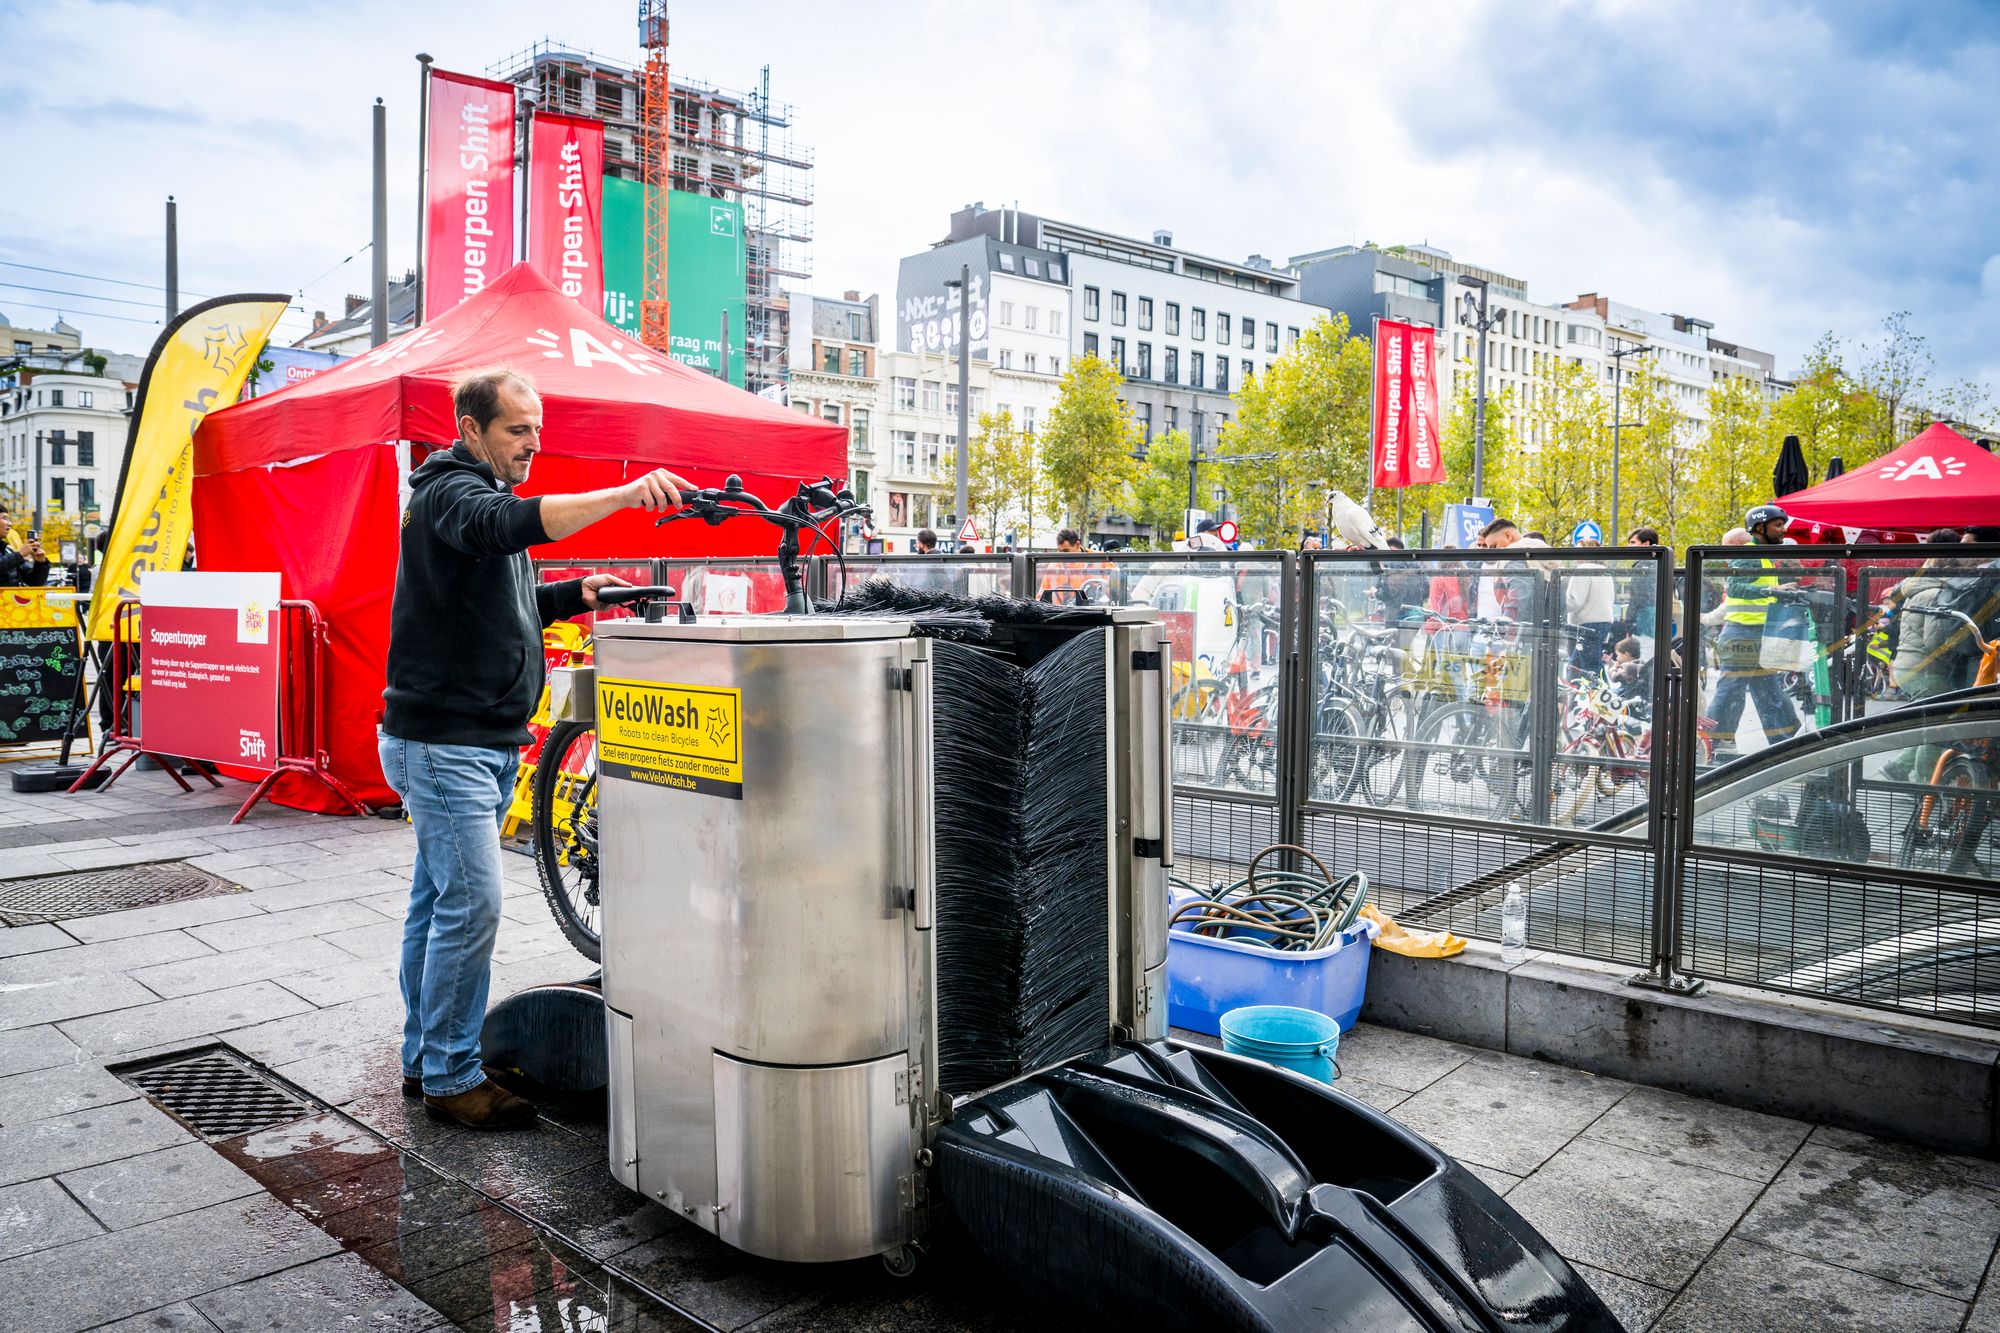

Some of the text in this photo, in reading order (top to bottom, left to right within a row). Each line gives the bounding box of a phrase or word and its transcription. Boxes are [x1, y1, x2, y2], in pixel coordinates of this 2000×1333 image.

[460, 103, 493, 304] werpen Shift
[559, 141, 588, 303] erpen Shift
[669, 335, 700, 352] raag
[1384, 336, 1402, 471] Antwerpen Shift
[1412, 340, 1431, 469] Antwerpen Shift
[1751, 510, 1767, 520] vol.
[150, 628, 207, 648] Sappentrapper
[602, 690, 699, 730] VeloWash
[240, 737, 266, 762] Shift
[618, 726, 699, 748] Robots to clean Bicycles
[603, 746, 730, 777] Snel een propere fiets zonder moeite
[630, 769, 697, 790] www.VeloWash.be
[537, 847, 554, 898] MEZCAL
